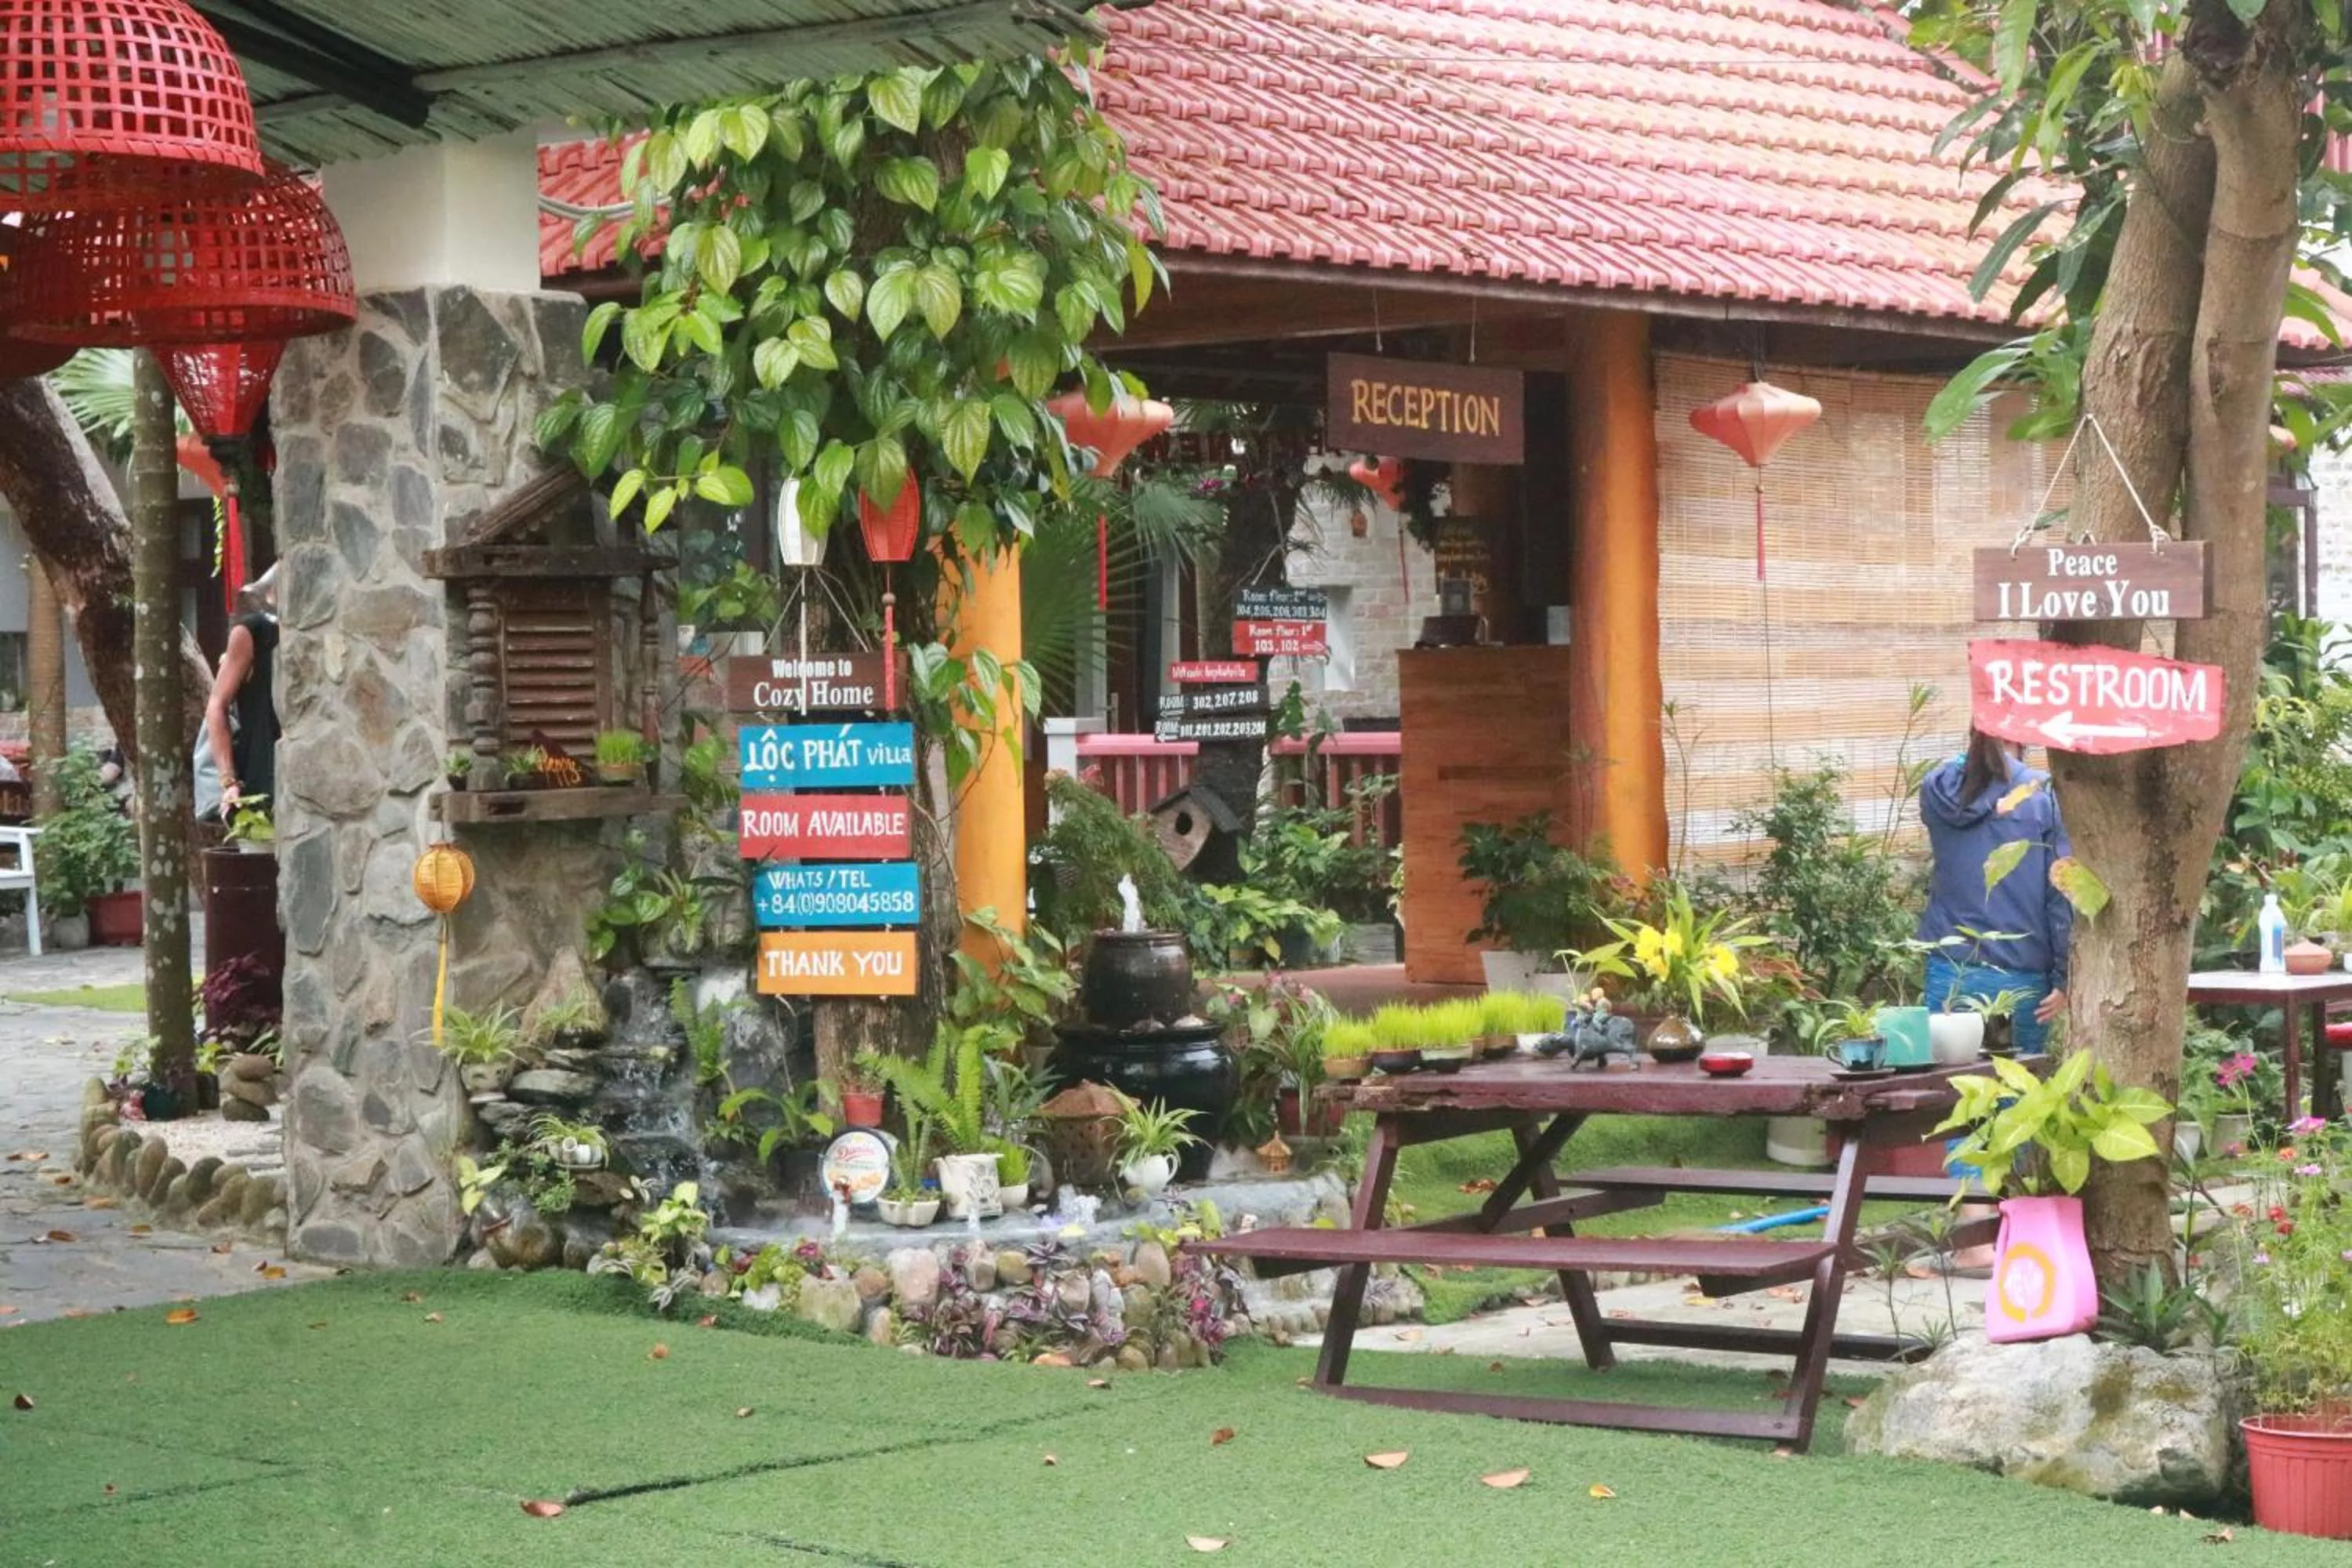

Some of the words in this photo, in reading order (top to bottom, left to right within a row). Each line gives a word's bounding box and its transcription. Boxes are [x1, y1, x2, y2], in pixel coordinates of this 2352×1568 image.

[1350, 379, 1500, 436] RECEPTION
[2047, 548, 2118, 576] Peace
[1998, 583, 2011, 619] I
[2020, 583, 2097, 619] Love
[2104, 579, 2170, 618] You
[771, 659, 835, 677] Welcome
[838, 659, 852, 676] to
[753, 681, 806, 710] Cozy
[811, 681, 873, 705] Home
[1985, 659, 2207, 713] RESTROOM
[744, 728, 795, 782] LỘC
[803, 724, 862, 770] PHÁT
[742, 809, 799, 838] ROOM
[808, 811, 906, 837] AVAILABLE
[765, 951, 846, 977] THANK
[851, 951, 902, 976] YOU
